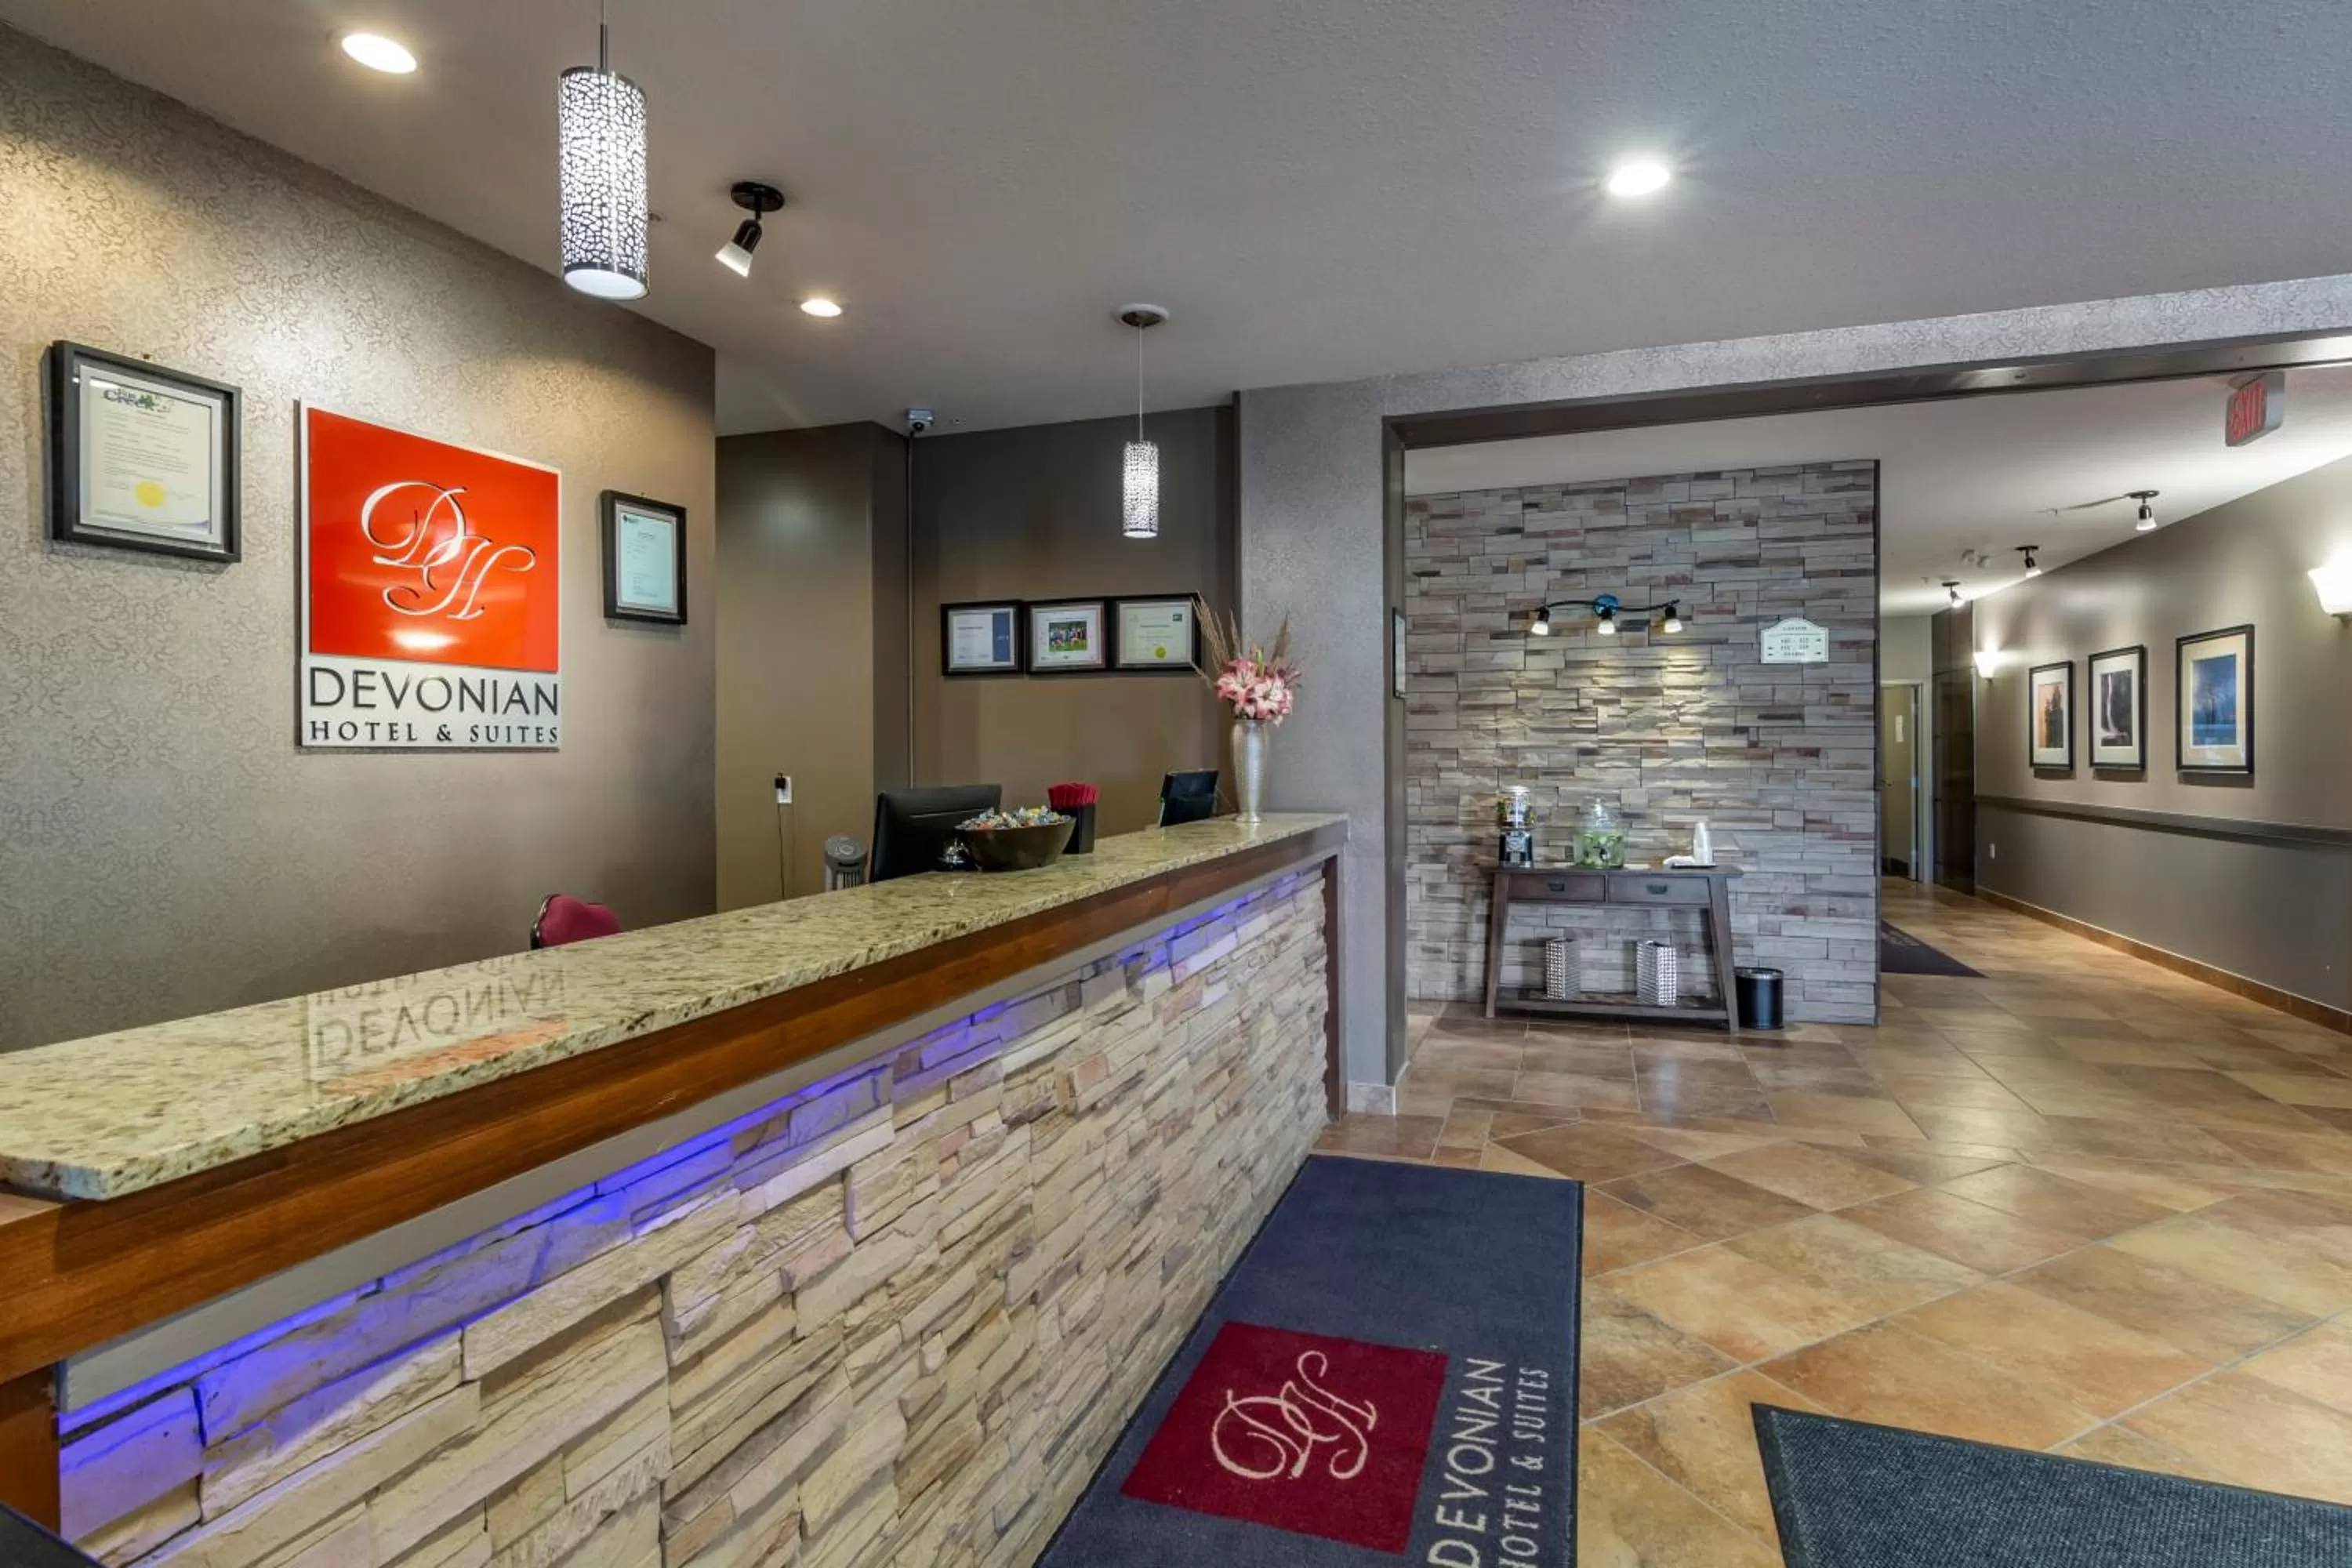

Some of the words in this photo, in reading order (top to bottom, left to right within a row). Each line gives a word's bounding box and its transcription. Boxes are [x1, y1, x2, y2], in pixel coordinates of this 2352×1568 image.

[310, 666, 558, 716] DEVONIAN
[309, 720, 418, 741] HOTEL
[436, 724, 452, 742] &
[470, 724, 558, 743] SUITES
[1512, 1367, 1549, 1443] SUITES
[1427, 1357, 1506, 1568] DEVONIAN
[1510, 1455, 1544, 1471] &
